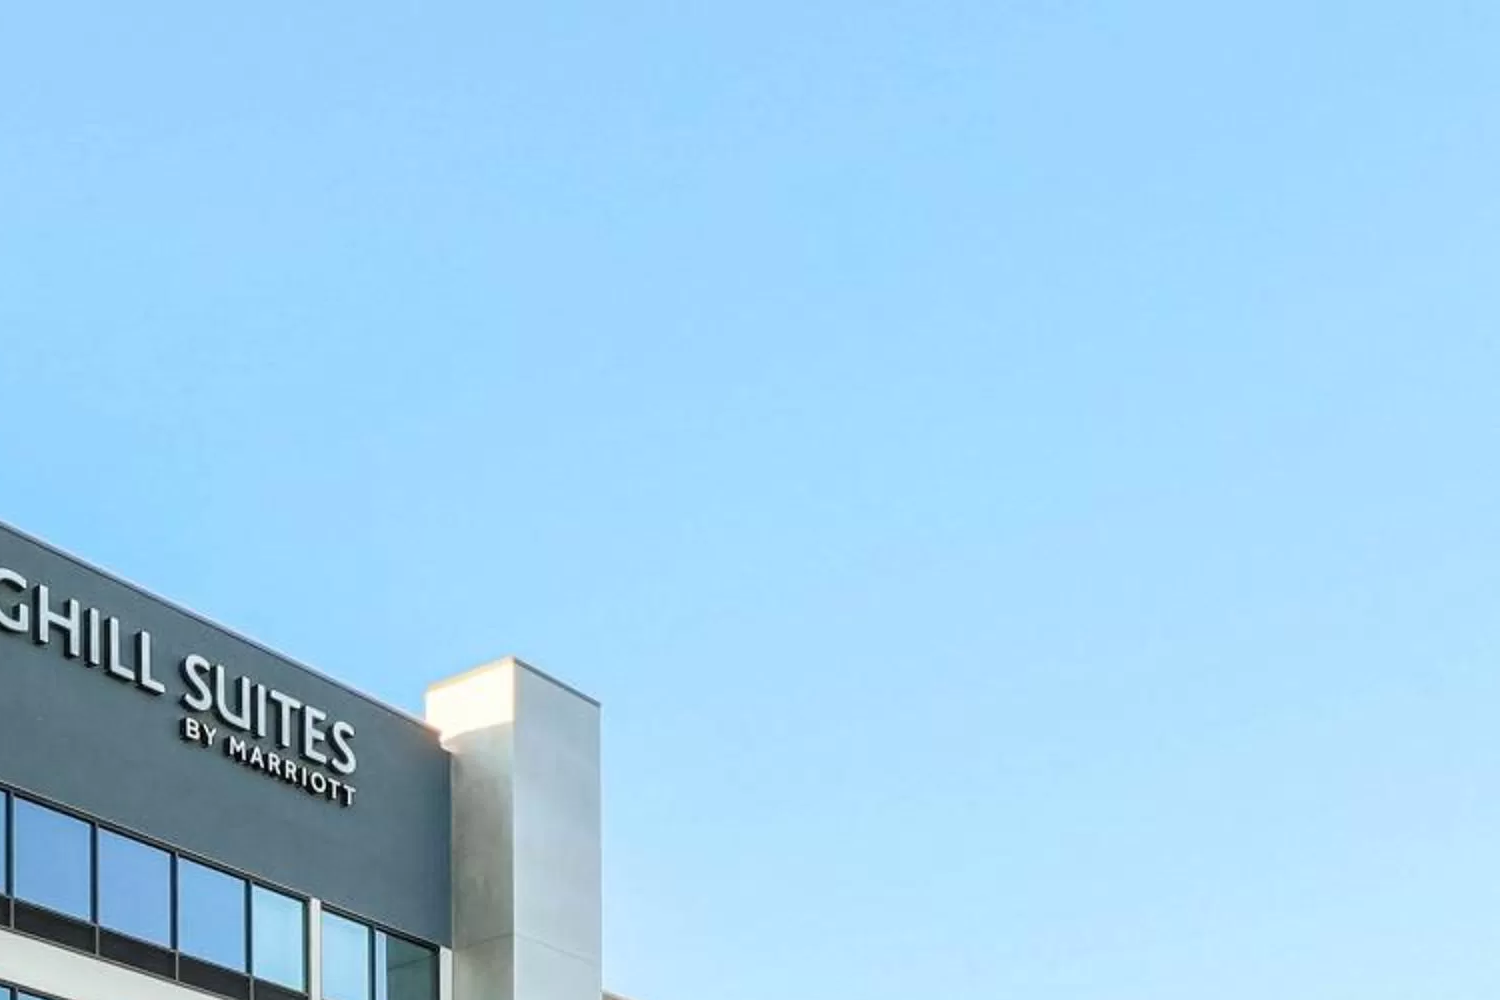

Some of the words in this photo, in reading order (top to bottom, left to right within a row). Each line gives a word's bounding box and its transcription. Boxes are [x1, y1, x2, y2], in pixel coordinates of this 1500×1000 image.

[183, 653, 357, 774] SUITES
[183, 716, 217, 746] BY
[227, 735, 356, 806] MARRIOTT
